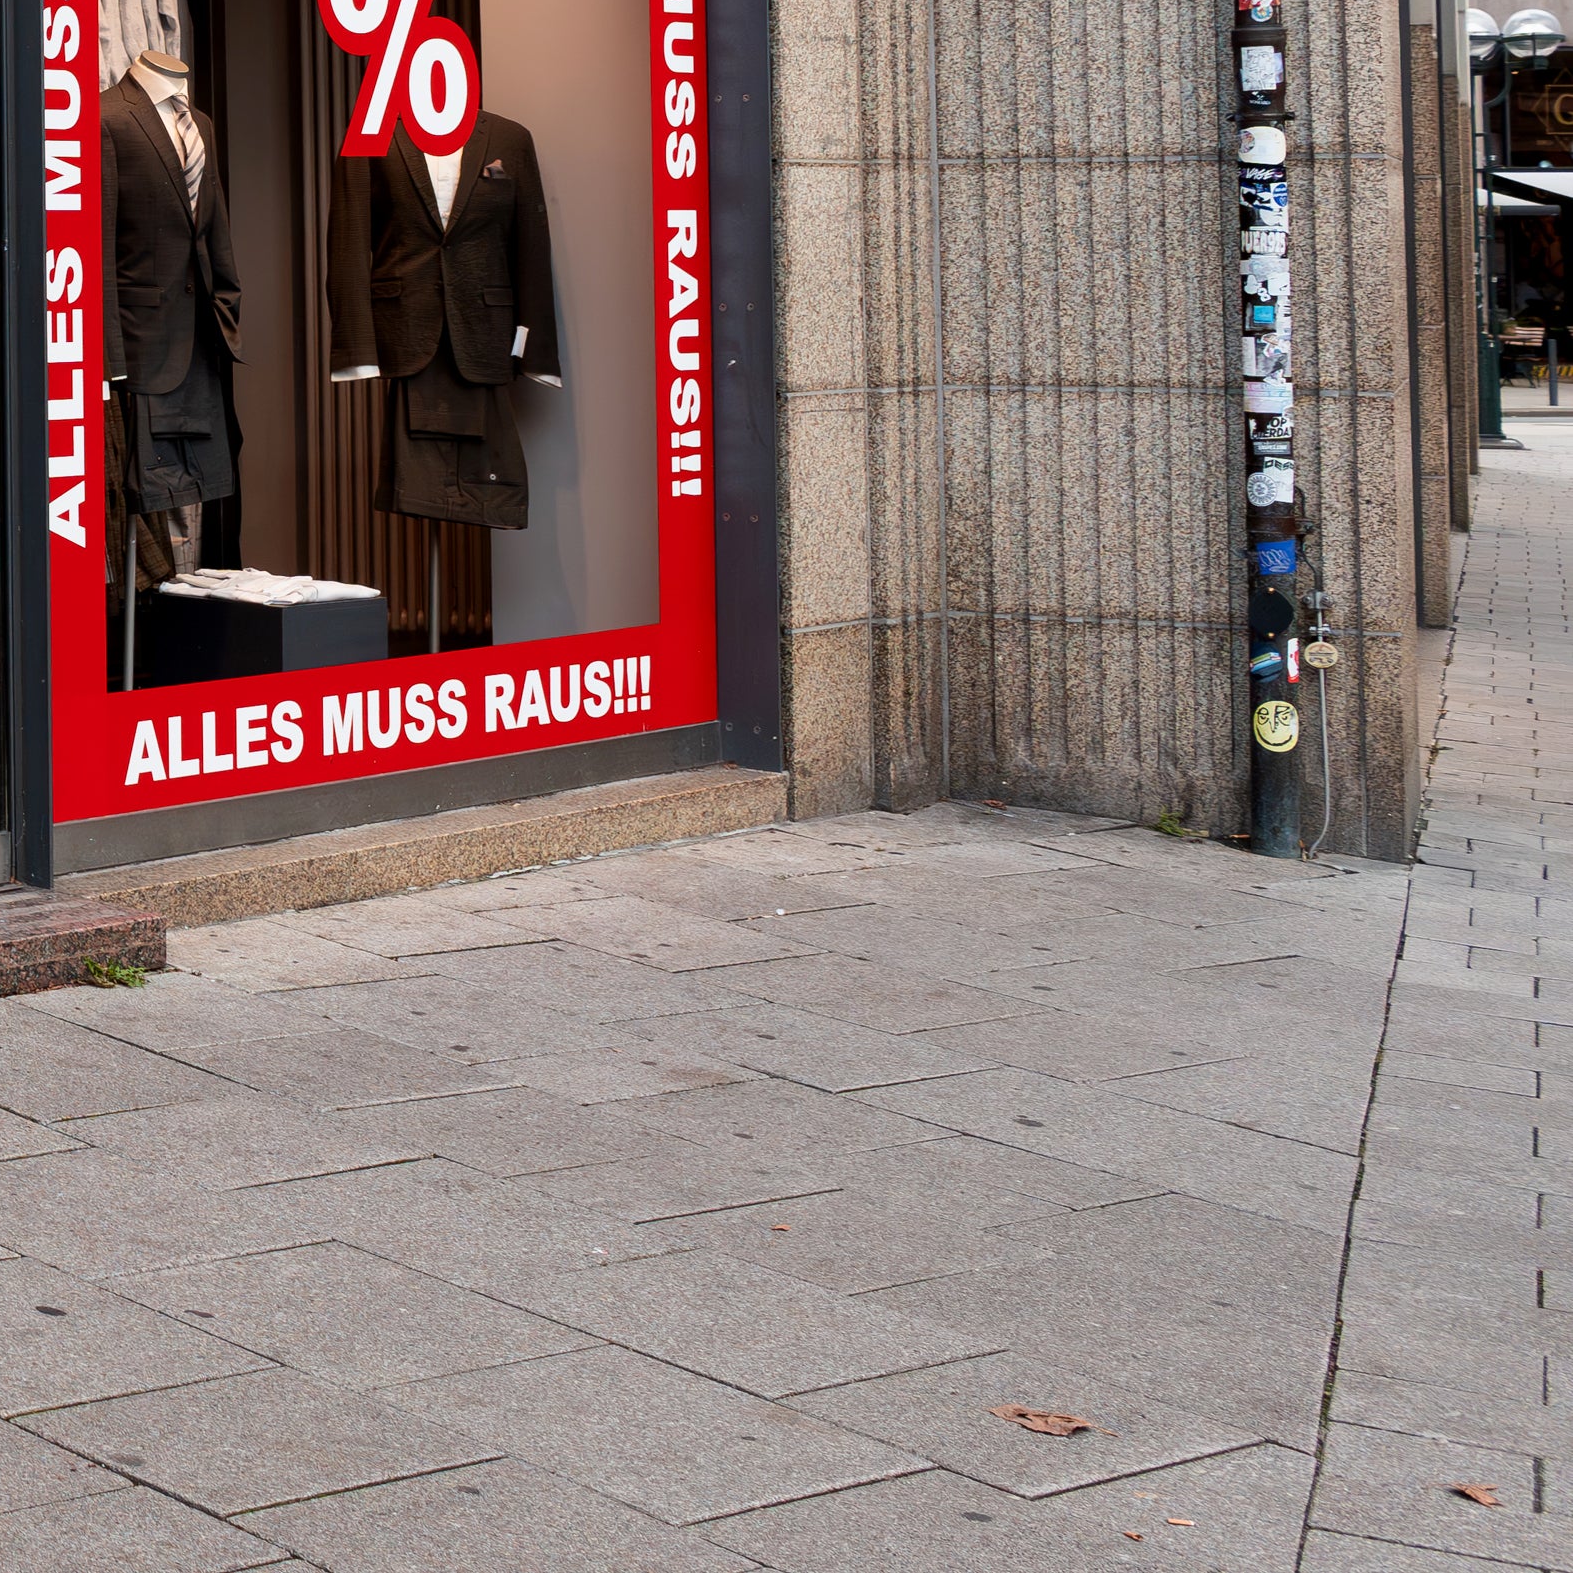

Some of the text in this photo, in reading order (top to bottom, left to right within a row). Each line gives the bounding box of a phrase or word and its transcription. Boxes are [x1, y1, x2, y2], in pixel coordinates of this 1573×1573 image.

[45, 247, 86, 548] ALLES
[668, 210, 702, 496] RAUS!!!
[125, 656, 652, 786] ALLES MUSS RAUS!!!
